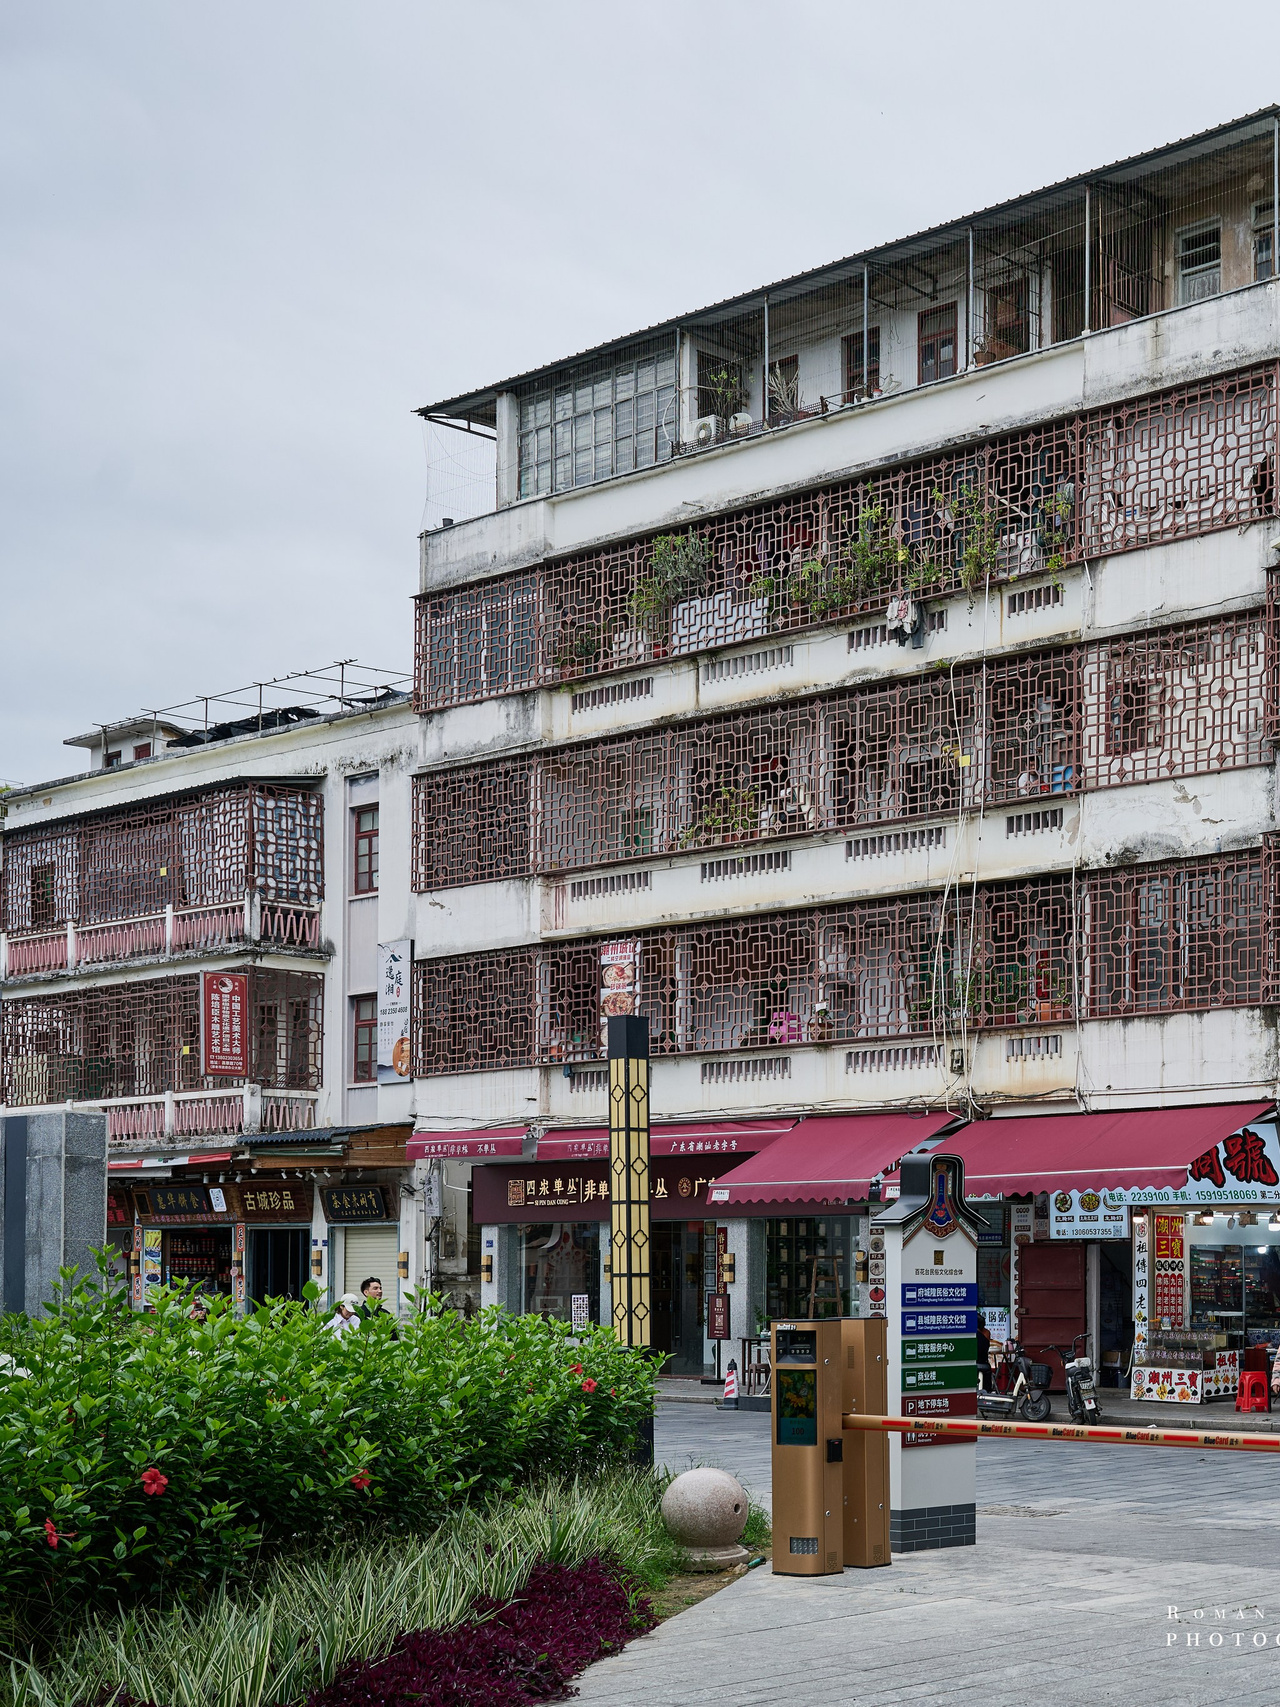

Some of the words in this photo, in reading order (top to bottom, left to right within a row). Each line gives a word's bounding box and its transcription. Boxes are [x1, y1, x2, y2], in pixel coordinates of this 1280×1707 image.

[1130, 1191, 1170, 1201] 2239100
[1195, 1189, 1257, 1200] 15919518069
[244, 1190, 295, 1211] 古城珍品
[1157, 1217, 1182, 1236] 潮州
[914, 1268, 964, 1276] 百花台民俗文化综合体
[917, 1287, 967, 1297] 府城隍民俗文化馆
[917, 1314, 967, 1325] 县城隍民俗文化馆
[917, 1342, 955, 1353] 游客服务中心
[917, 1371, 936, 1381] 商业楼
[917, 1398, 949, 1409] 地下停车场
[914, 1421, 935, 1429] BlueCard
[981, 1424, 1003, 1433] BlueCard
[1052, 1428, 1075, 1437] BlueCard
[1125, 1431, 1150, 1441] BlueCard
[1203, 1436, 1229, 1446] BlueCard
